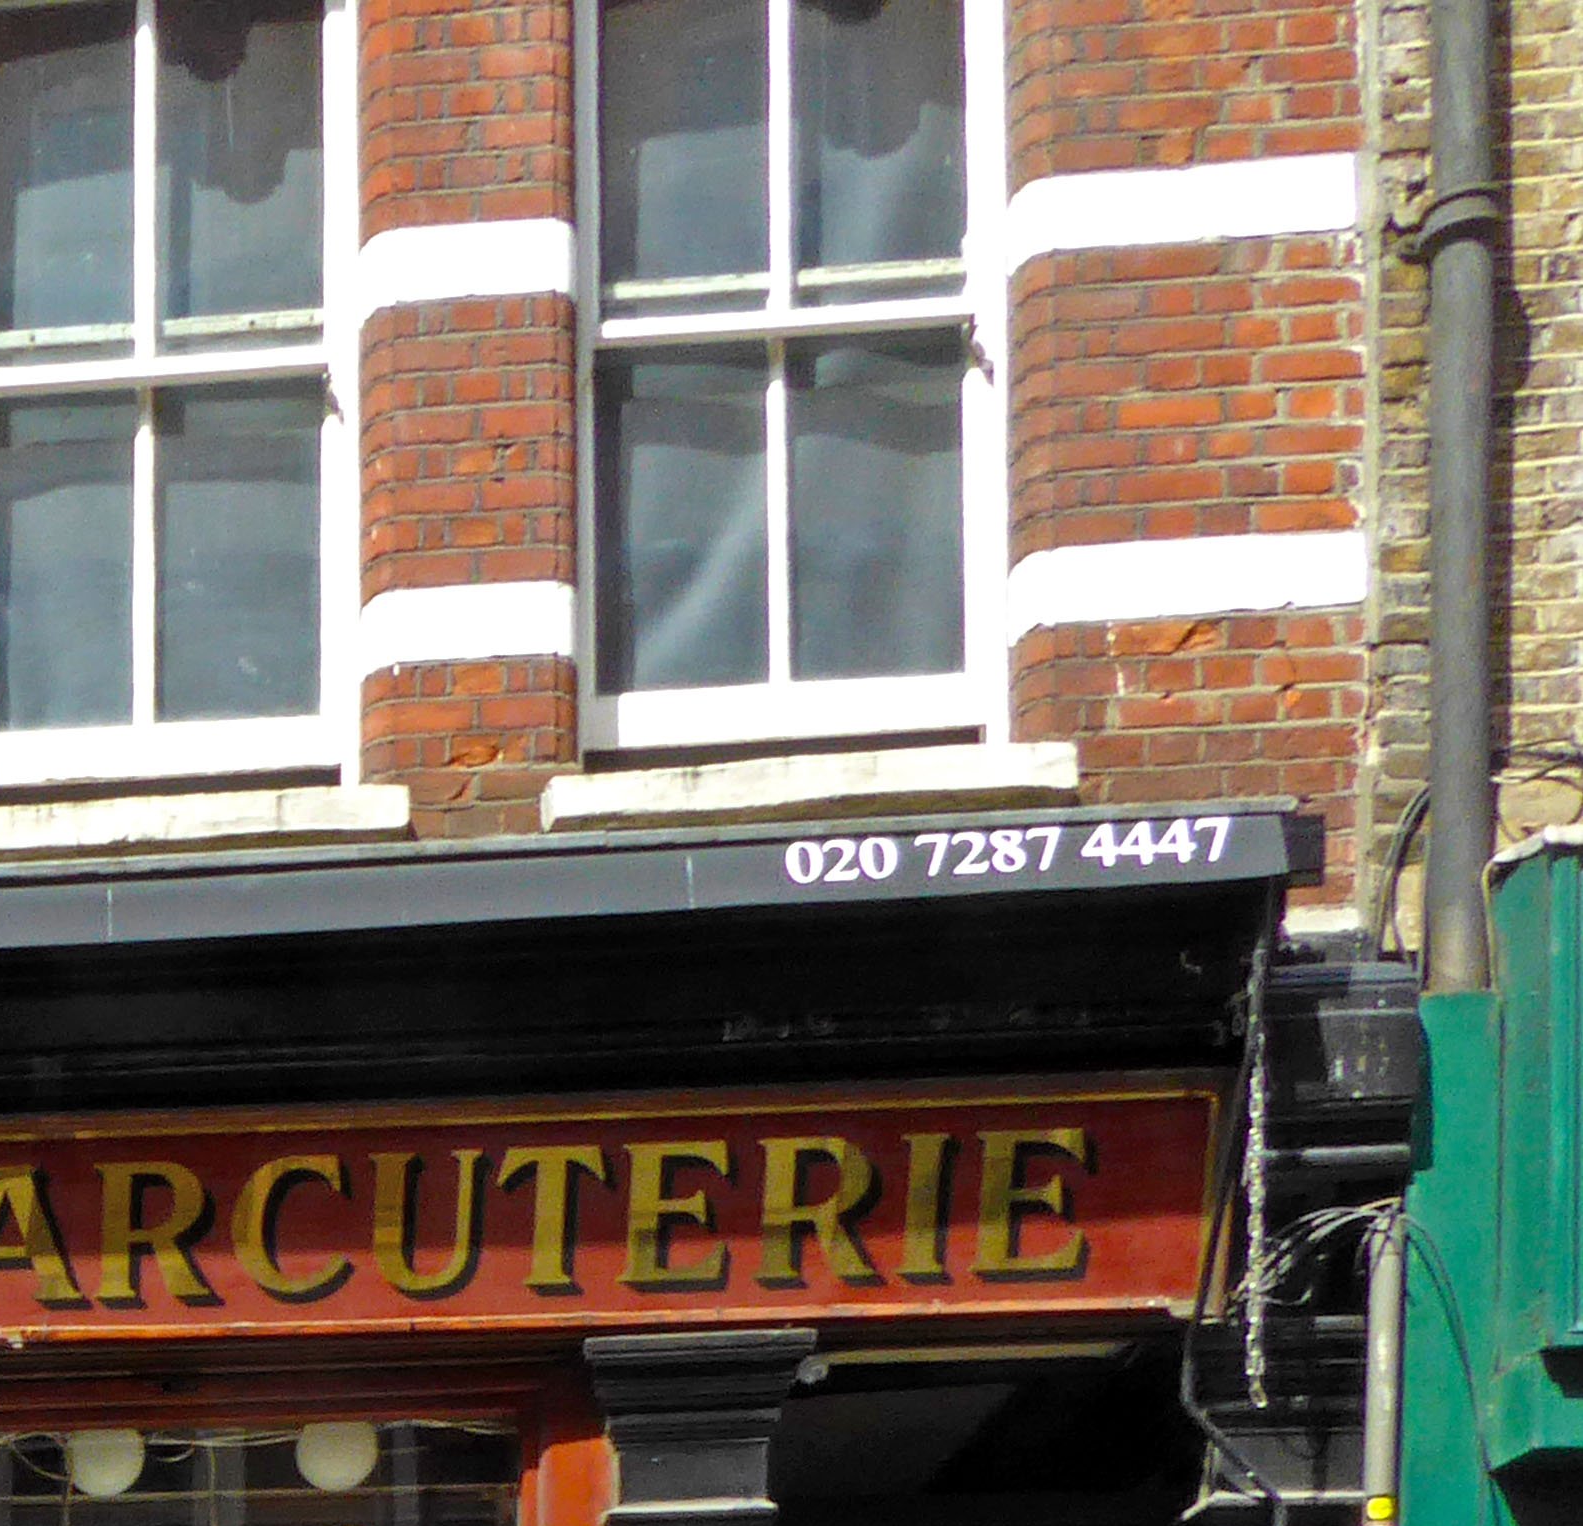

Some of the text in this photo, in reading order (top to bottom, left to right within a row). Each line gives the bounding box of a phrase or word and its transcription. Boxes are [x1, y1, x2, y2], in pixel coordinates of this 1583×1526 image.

[784, 816, 1232, 884] 020 7287 4447
